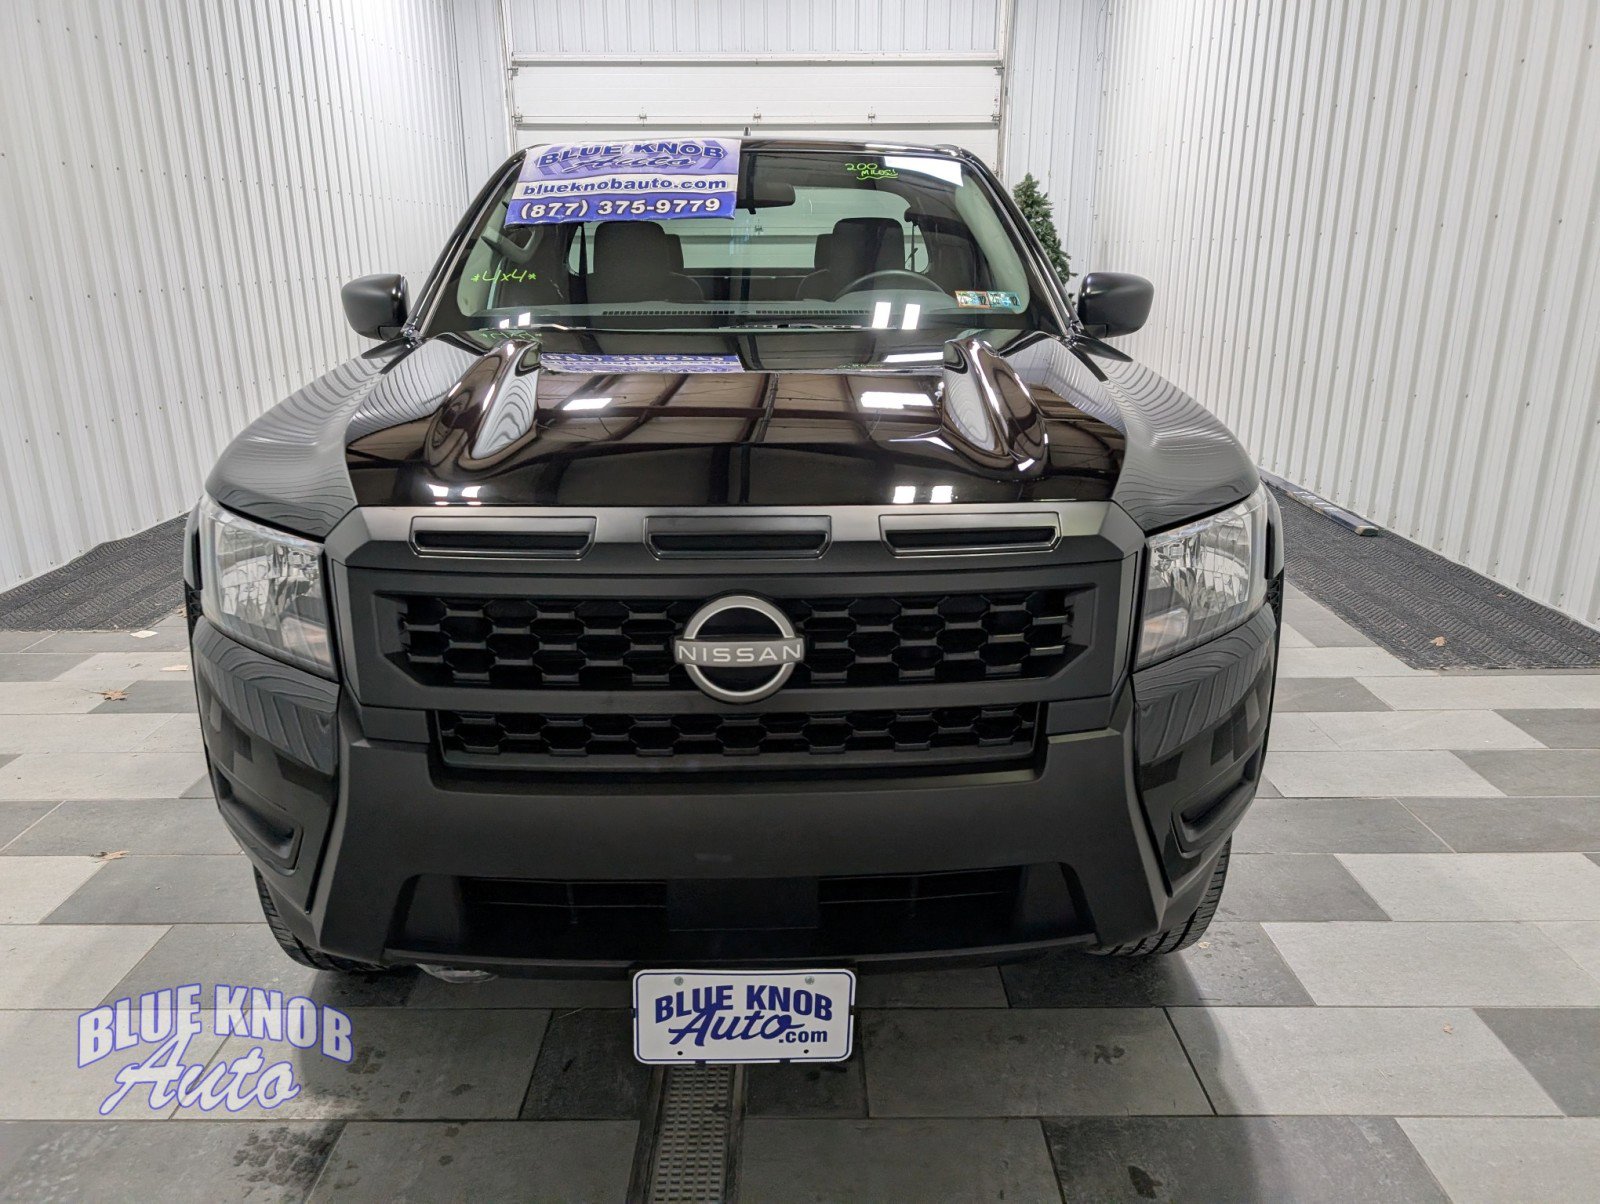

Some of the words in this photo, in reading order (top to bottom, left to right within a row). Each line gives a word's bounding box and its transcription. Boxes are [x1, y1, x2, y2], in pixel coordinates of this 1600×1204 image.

[539, 142, 623, 167] BLUE
[633, 141, 725, 159] KNOB
[561, 154, 697, 173] Auto
[523, 177, 728, 196] blueknobauto.com
[520, 199, 589, 220] (877)
[597, 198, 722, 215] 375-9779
[679, 644, 801, 662] NISSAN
[655, 985, 733, 1024] BLUE
[746, 985, 833, 1021] KNOB
